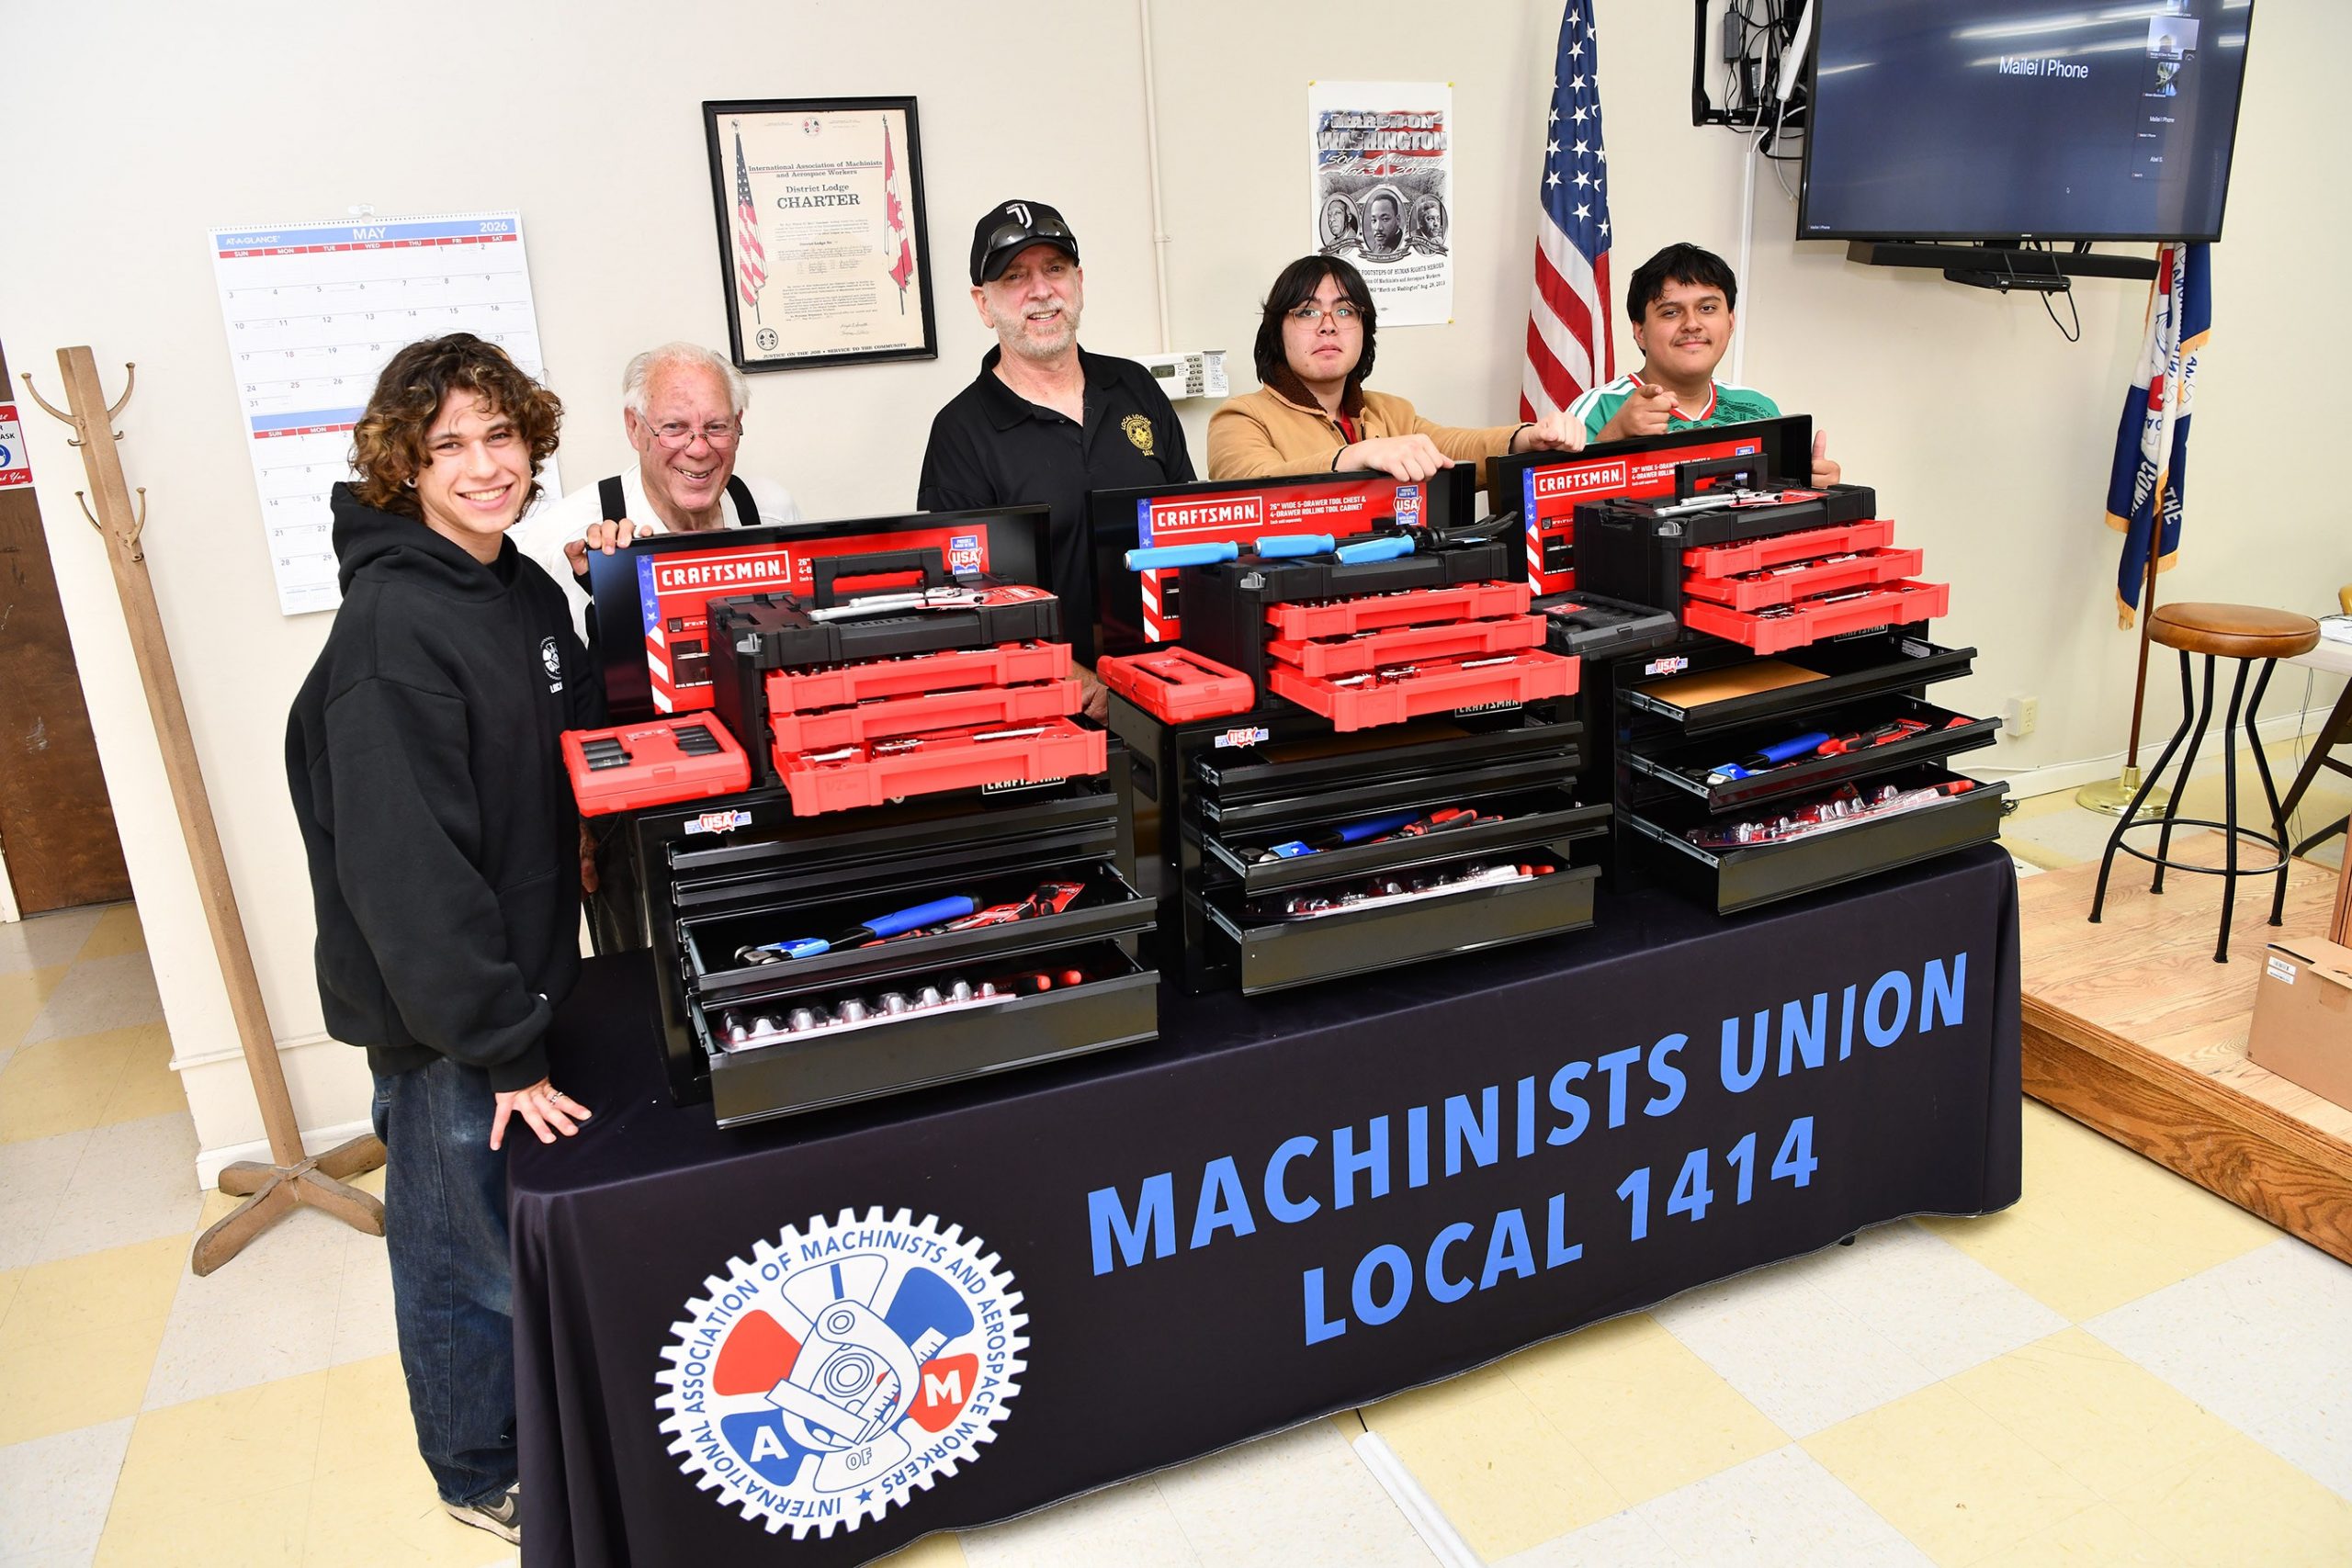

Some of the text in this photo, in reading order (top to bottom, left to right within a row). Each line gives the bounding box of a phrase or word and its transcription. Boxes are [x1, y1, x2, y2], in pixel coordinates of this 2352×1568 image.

[1999, 56, 2039, 75] Mailei
[2047, 59, 2088, 78] Phone
[1331, 115, 1434, 128] MARCH ON
[1317, 130, 1447, 151] WASHINGTON
[749, 164, 794, 172] International
[796, 162, 834, 170] Association
[786, 184, 849, 194] District Lodge
[776, 193, 860, 209] CHARTER
[353, 227, 386, 241] MAY
[480, 221, 507, 232] 2026
[1427, 262, 1444, 270] HEROES
[1539, 468, 1620, 492] CRAFTSMAN
[1658, 468, 1675, 477] ROLLIN
[1270, 509, 1301, 518] 4-DRAWER
[1340, 503, 1363, 512] CABINET
[1297, 499, 1328, 508] 5-DRAWER
[1396, 499, 1419, 511] USA
[2163, 486, 2184, 525] THE
[1157, 504, 1255, 527] CRAFTSMAN
[951, 551, 978, 564] USA
[661, 559, 781, 587] CRAFTSMAN
[1657, 660, 1676, 671] USA
[1229, 730, 1253, 743] USA
[703, 814, 733, 829] USA
[1089, 953, 1967, 1276] MACHINISTS UNION
[1305, 1116, 1818, 1346] LOCAL 1414
[830, 1262, 844, 1300] I
[683, 1229, 1007, 1518] INTERNATIONAL ASSOCIATION OF MACHINISTS AND AEROSPACE WORKERS
[923, 1369, 963, 1407] M
[749, 1425, 789, 1462] A
[845, 1447, 873, 1471] OF
